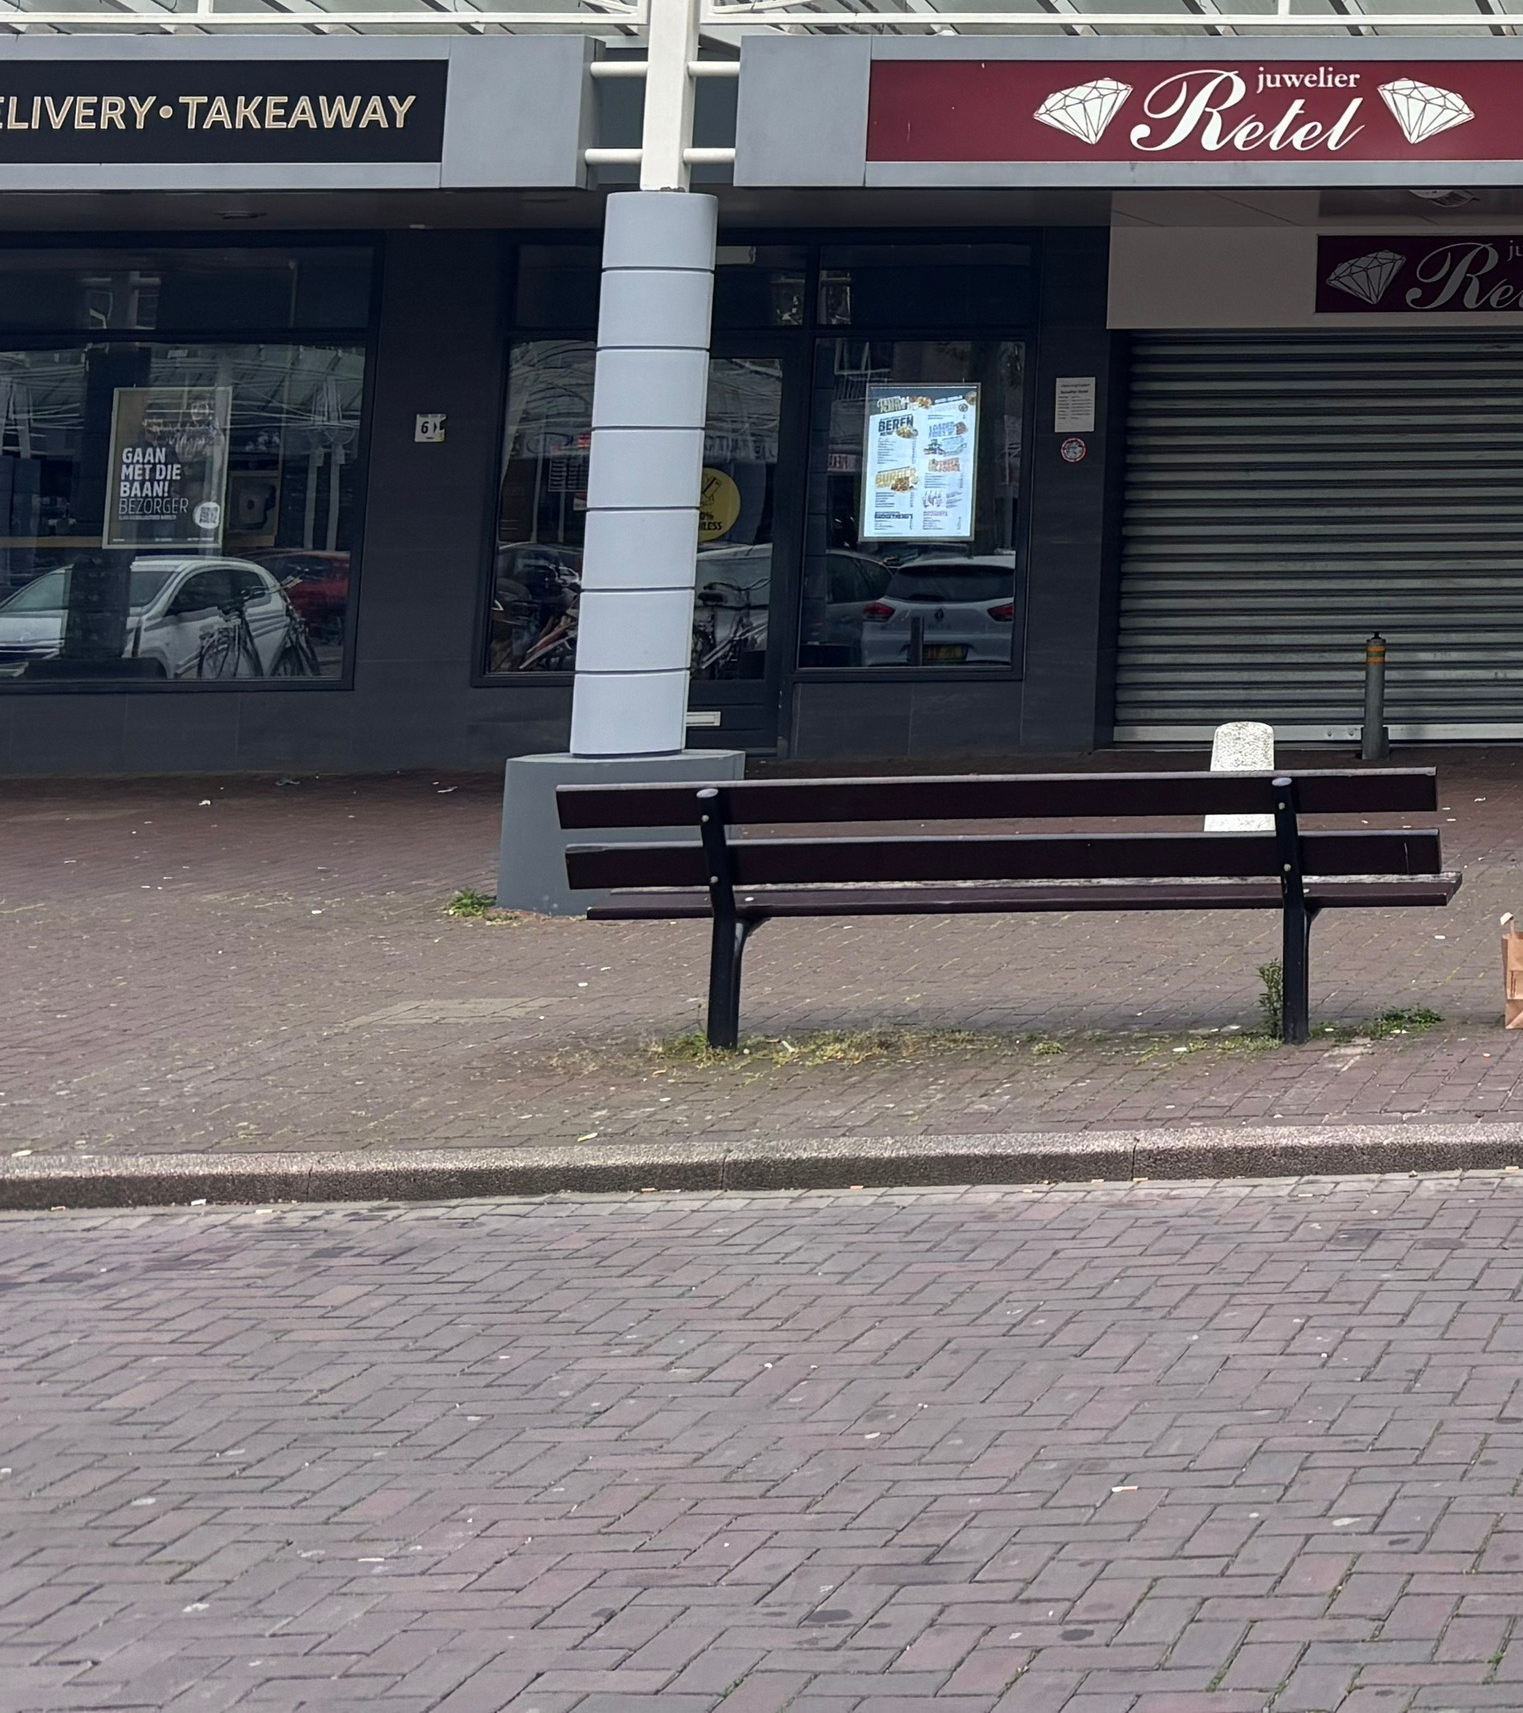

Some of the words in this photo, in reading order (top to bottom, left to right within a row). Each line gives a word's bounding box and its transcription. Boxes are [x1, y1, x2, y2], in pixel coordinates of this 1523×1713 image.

[1256, 66, 1361, 94] juwelier
[0, 94, 157, 130] LIVERY
[1130, 69, 1365, 152] Retel
[420, 420, 430, 435] 6
[122, 447, 166, 463] GAAN
[120, 464, 153, 480] MET
[155, 463, 182, 480] DIE
[119, 480, 169, 497] BAAN!
[118, 497, 189, 515] BEZORGER
